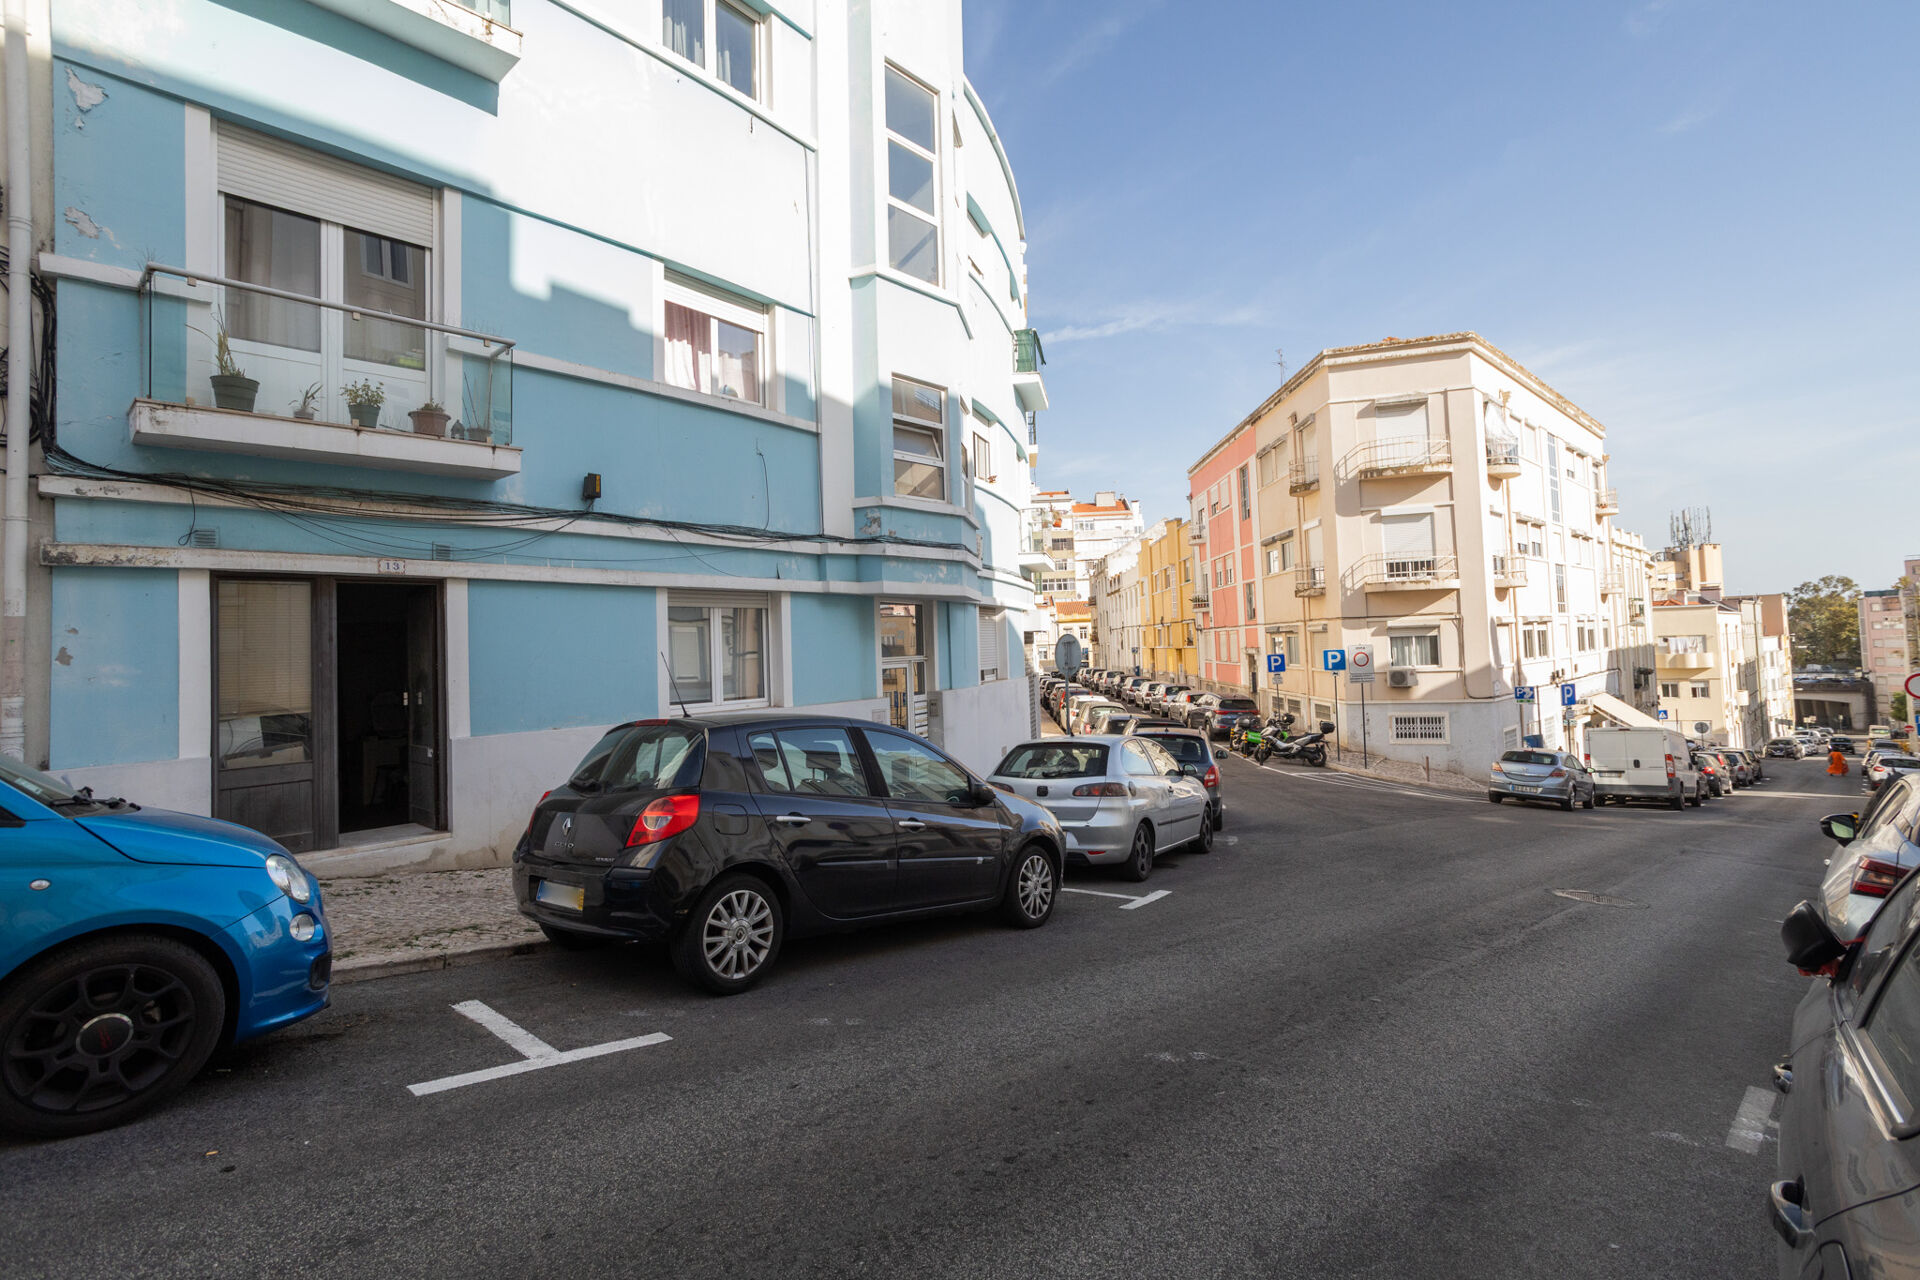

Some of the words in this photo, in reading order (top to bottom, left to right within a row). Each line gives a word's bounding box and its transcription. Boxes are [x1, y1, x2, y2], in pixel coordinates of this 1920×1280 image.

[386, 562, 400, 570] 13
[1271, 656, 1281, 671] P
[1328, 651, 1341, 669] P
[1517, 688, 1524, 697] P
[1564, 686, 1573, 704] P
